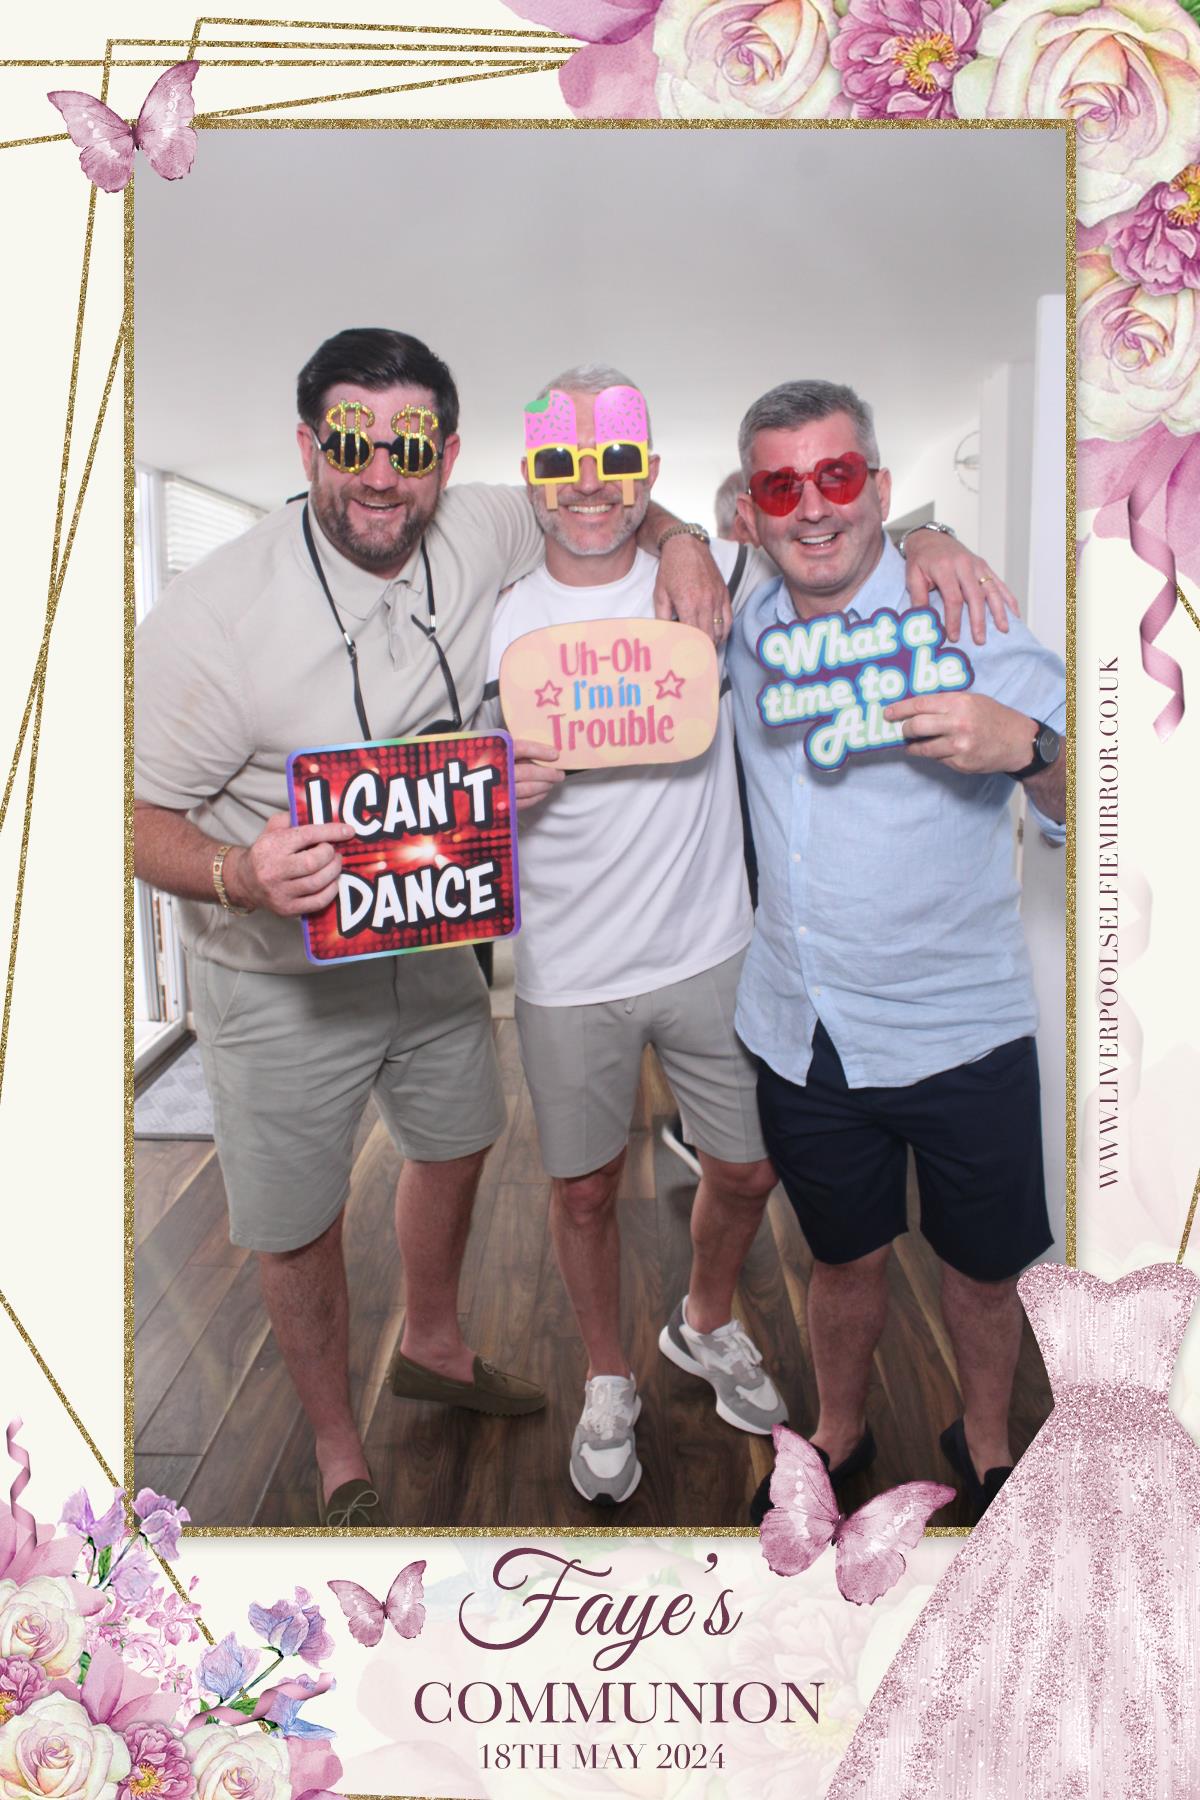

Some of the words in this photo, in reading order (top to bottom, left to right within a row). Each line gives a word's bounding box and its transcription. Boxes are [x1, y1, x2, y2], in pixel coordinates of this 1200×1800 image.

[560, 638, 651, 676] Uh-Oh
[762, 616, 898, 676] What
[903, 613, 939, 646] a
[573, 679, 613, 711] I'm
[618, 676, 641, 707] in
[762, 680, 857, 721] time
[858, 665, 906, 700] to
[911, 645, 967, 693] be
[547, 704, 675, 751] Trouble
[308, 779, 325, 825] I
[342, 761, 494, 836] CAN'T
[337, 862, 496, 933] DANCE
